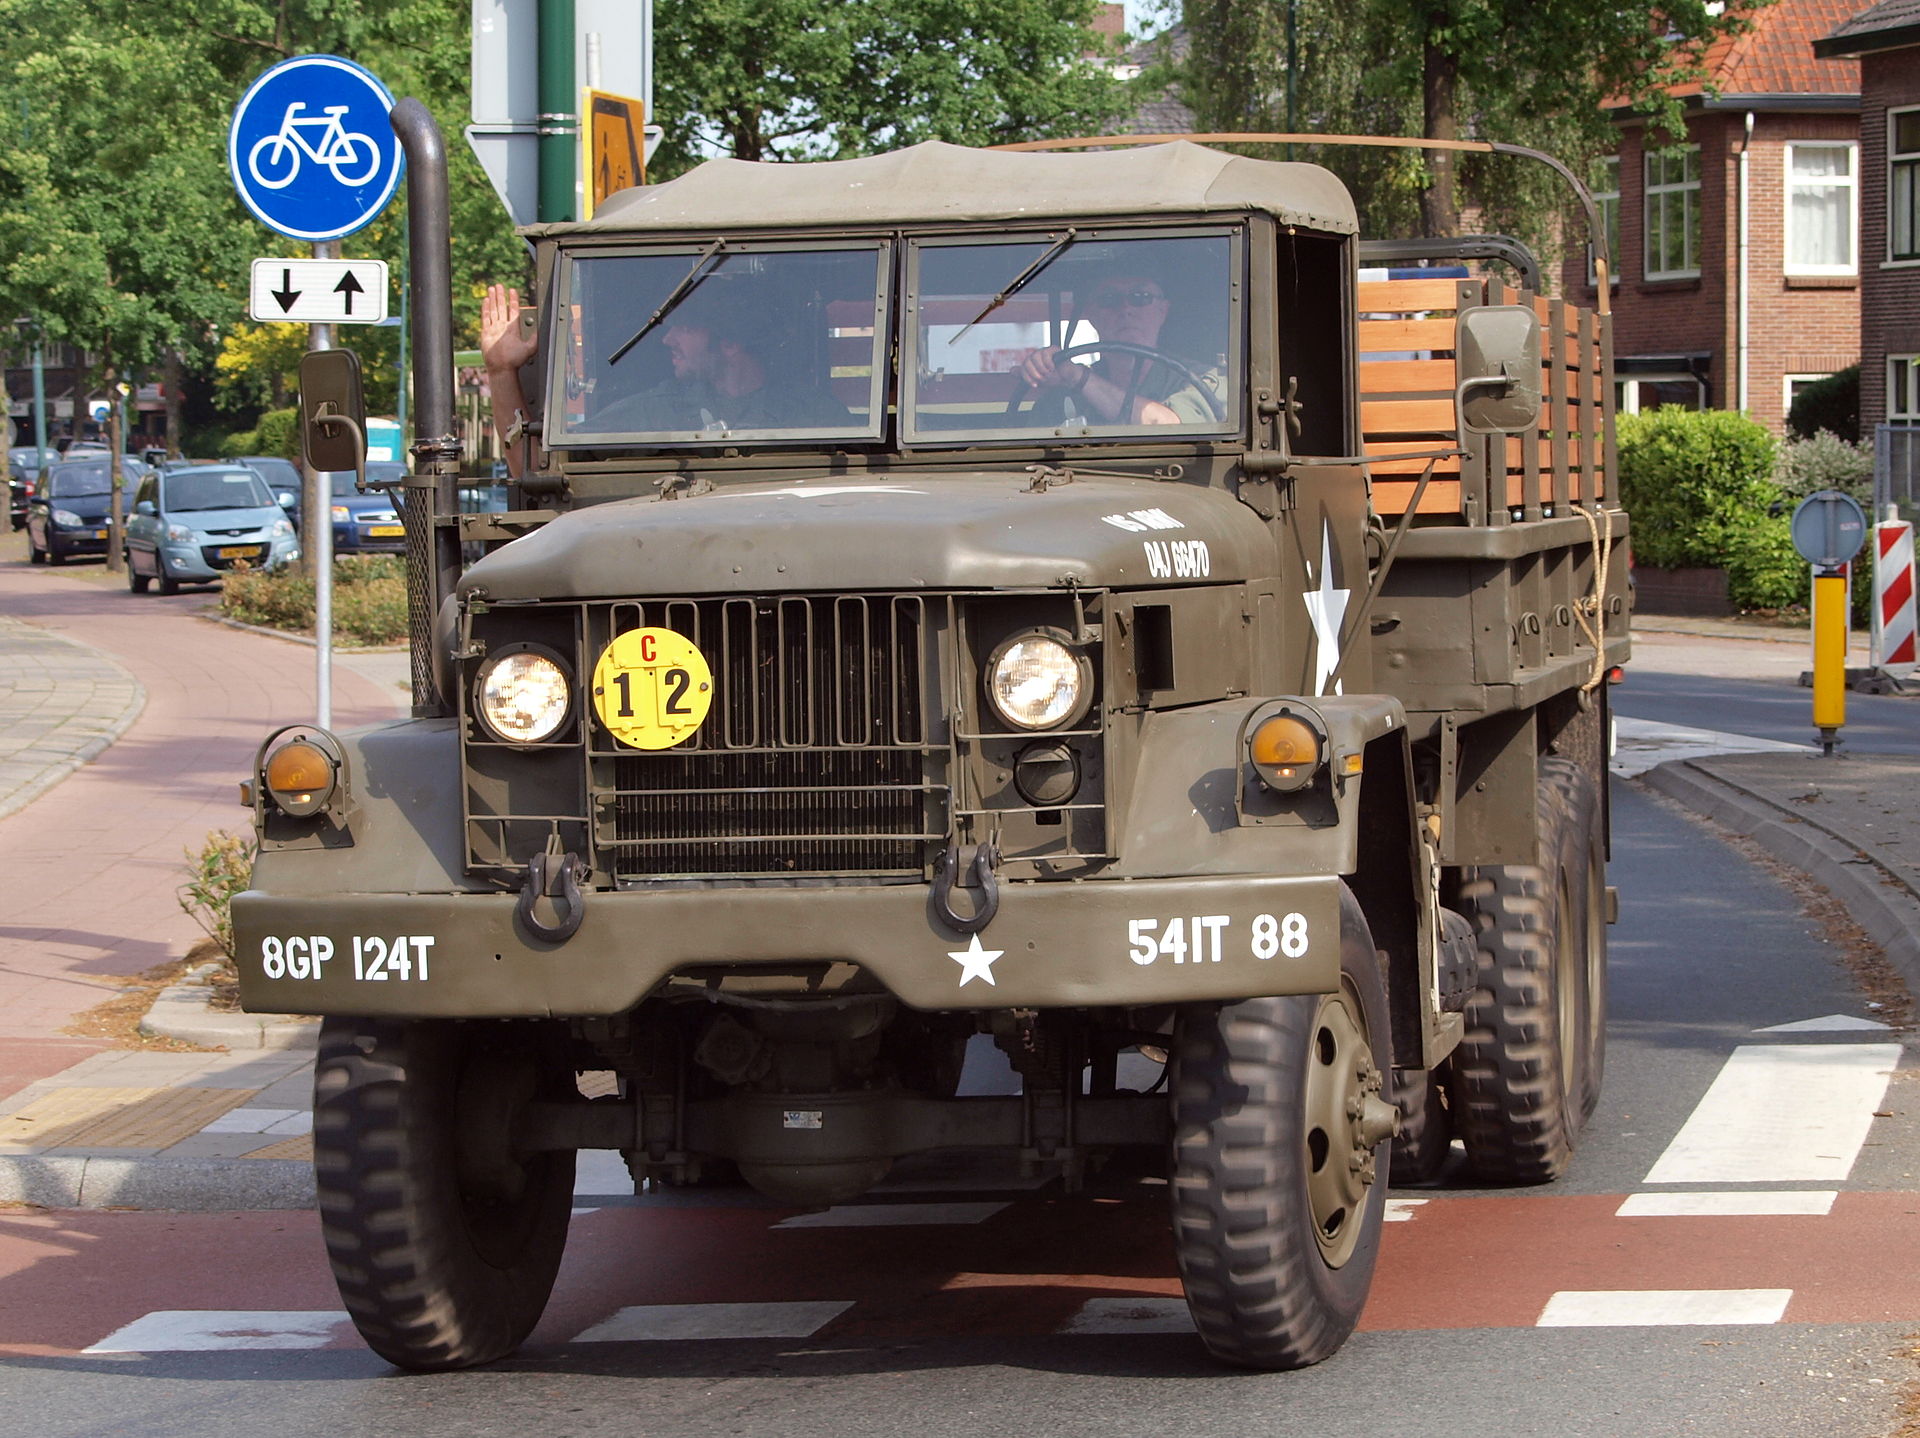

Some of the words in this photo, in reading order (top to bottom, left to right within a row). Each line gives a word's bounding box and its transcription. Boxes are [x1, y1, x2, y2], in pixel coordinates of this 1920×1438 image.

[641, 635, 657, 662] C
[261, 935, 335, 980] 8GP
[1250, 912, 1309, 960] 88
